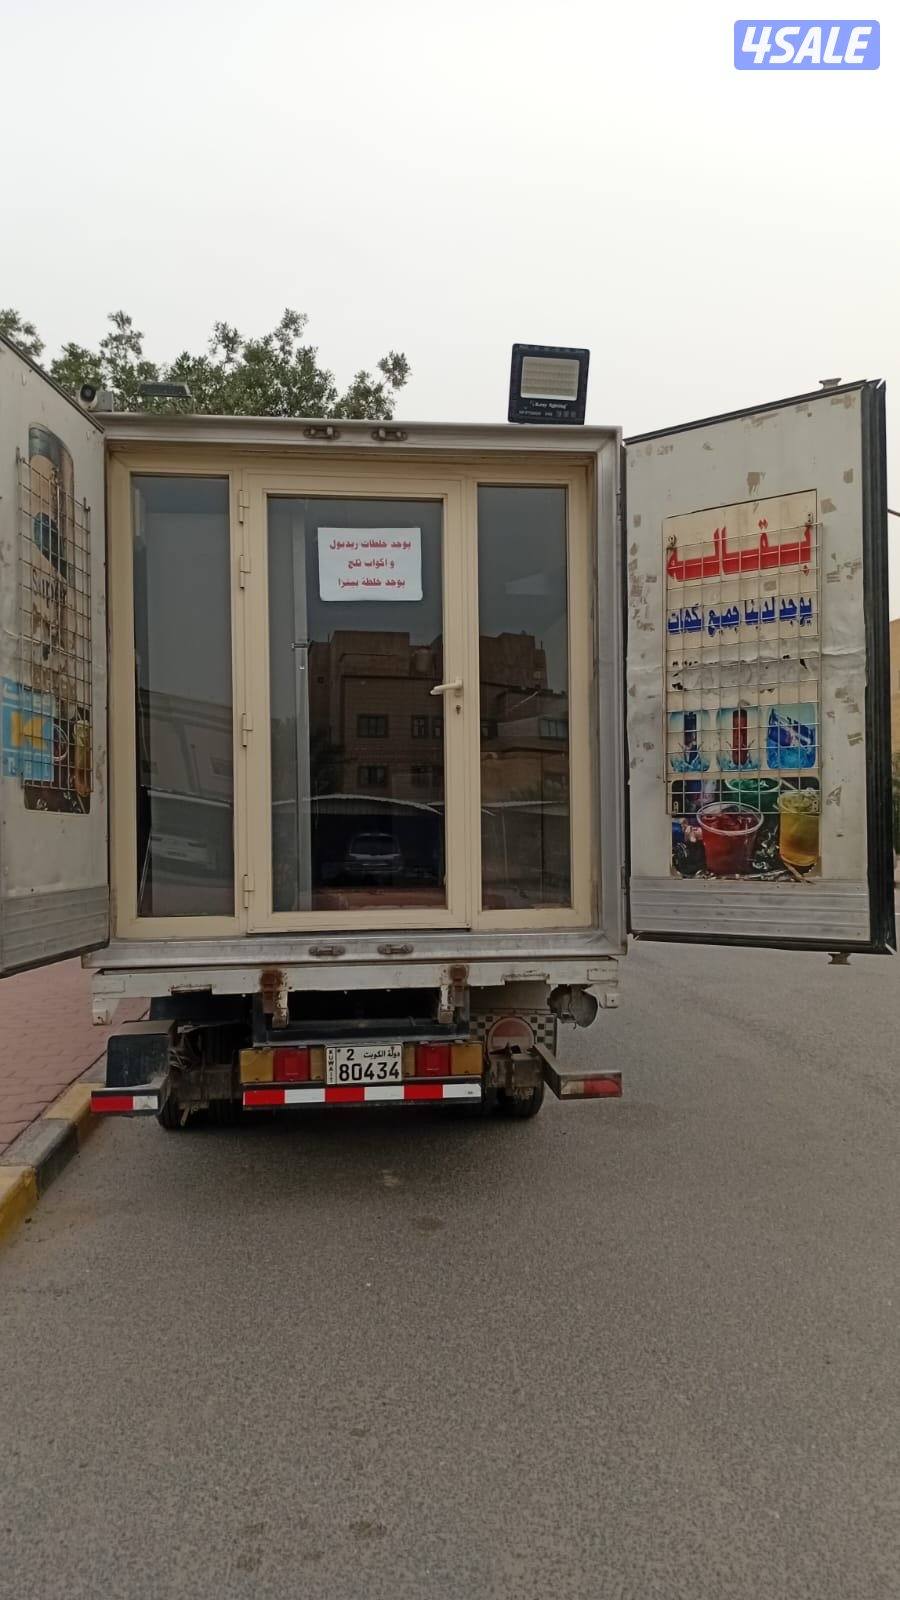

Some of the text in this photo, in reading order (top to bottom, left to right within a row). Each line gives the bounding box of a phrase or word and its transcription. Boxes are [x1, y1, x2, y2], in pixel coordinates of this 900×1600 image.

[391, 540, 412, 550] يوجد
[385, 578, 406, 588] يوجد
[707, 605, 740, 637] جميع
[744, 596, 775, 630] لدينا
[779, 596, 812, 626] يوجد
[346, 1048, 355, 1061] 2
[363, 1050, 386, 1060] الكويت
[327, 1049, 335, 1083] KUWAIT
[339, 1061, 400, 1082] 80434
